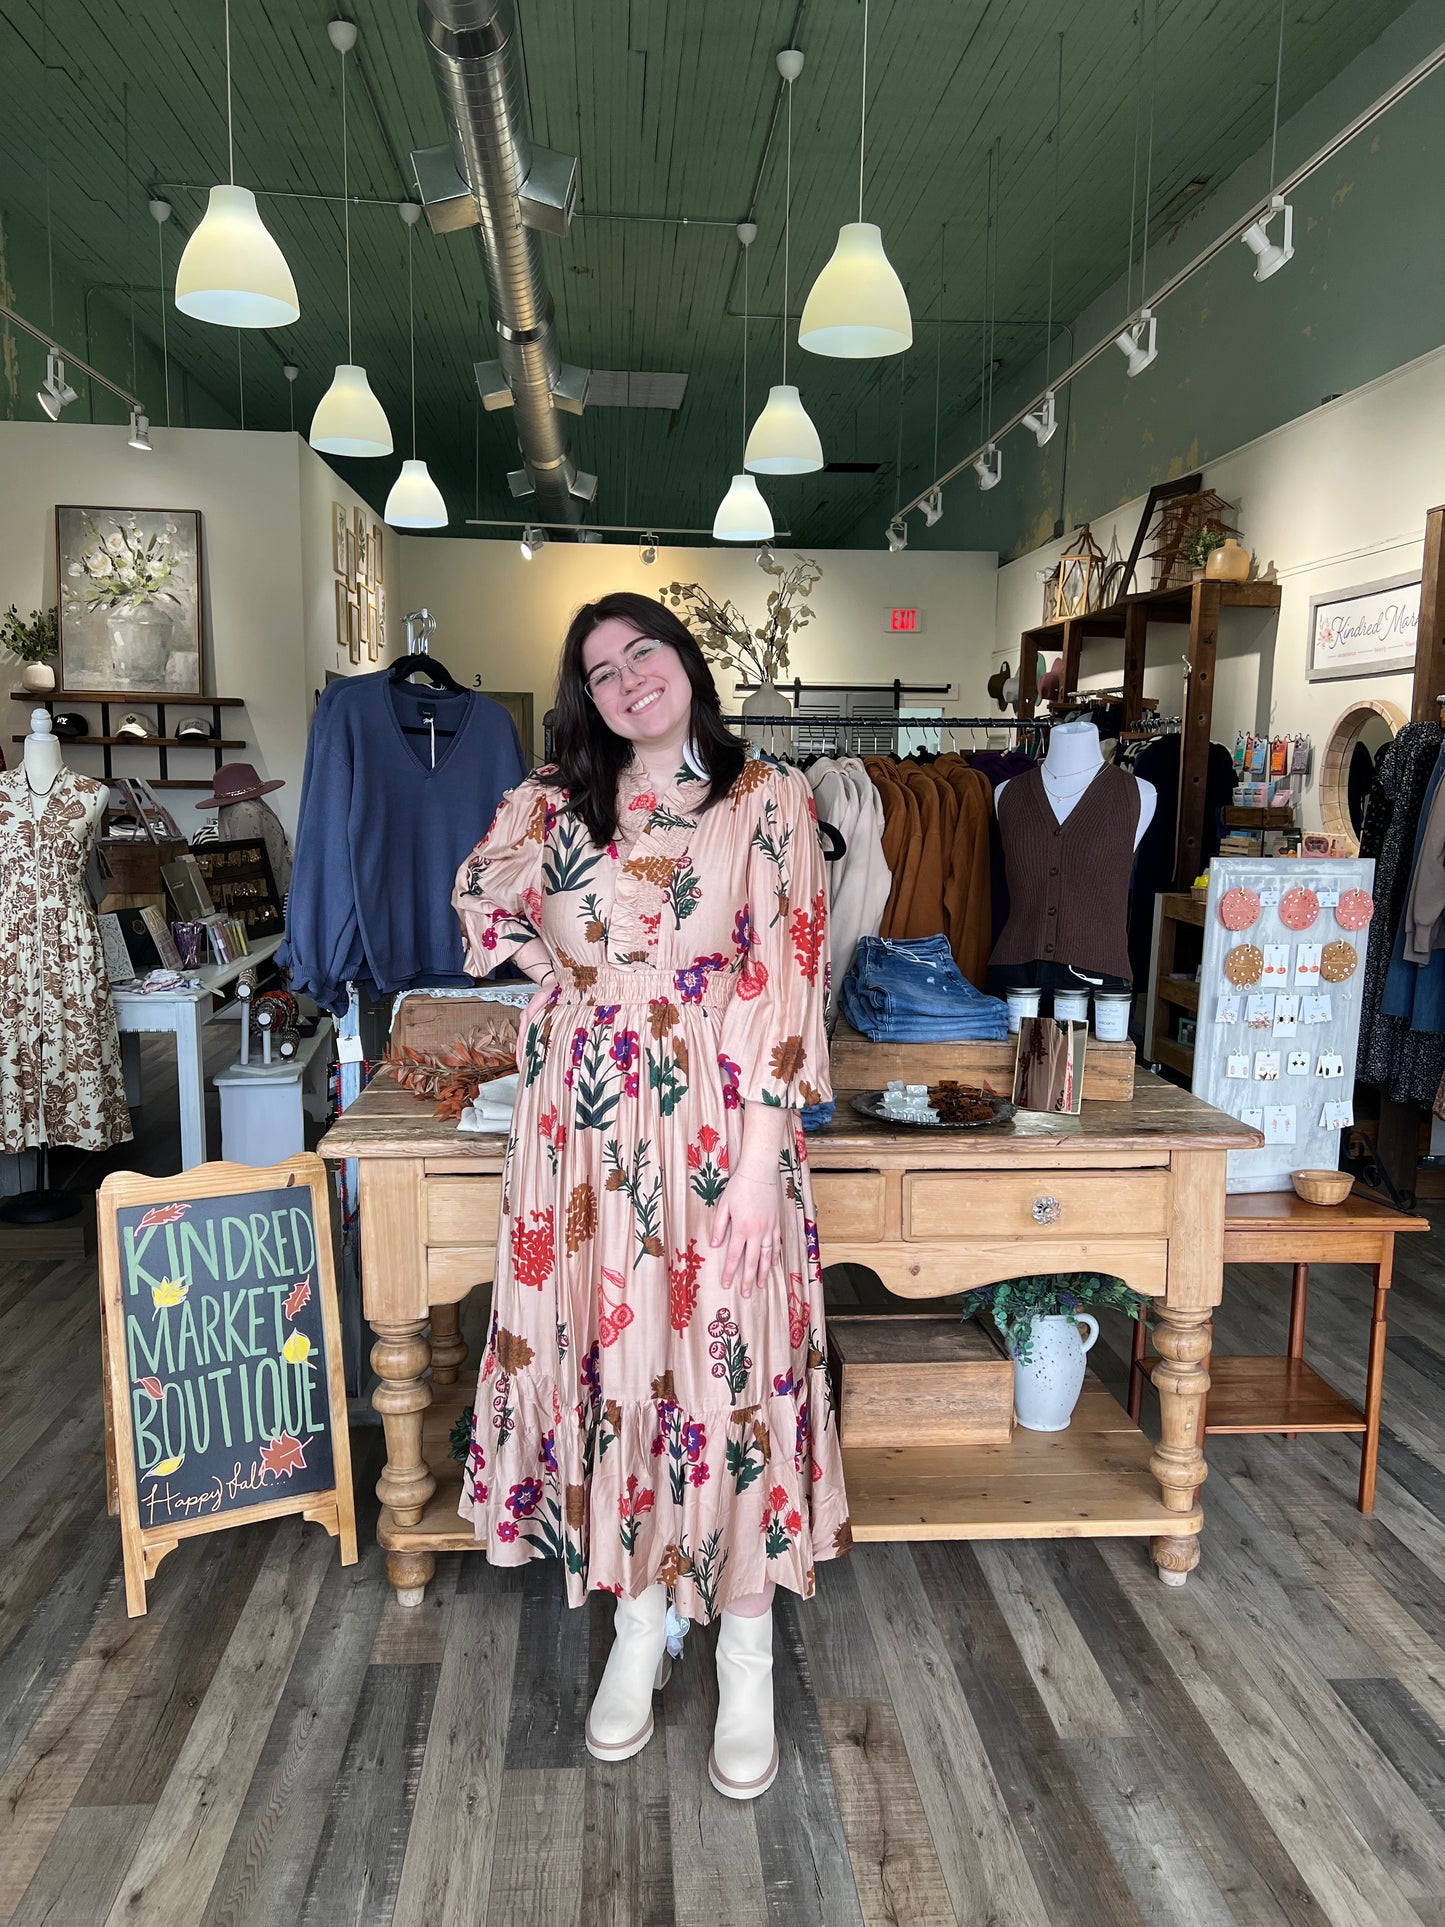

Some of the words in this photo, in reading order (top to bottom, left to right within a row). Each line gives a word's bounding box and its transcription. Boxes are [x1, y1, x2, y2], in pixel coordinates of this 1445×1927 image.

[891, 608, 917, 631] EXIT
[1329, 611, 1385, 650] Kindred
[472, 673, 482, 688] 3
[122, 1207, 316, 1296] KINDRED
[127, 1283, 289, 1382] MARKET
[131, 1347, 325, 1470] BOUTIQUE
[141, 1476, 223, 1525] Happy
